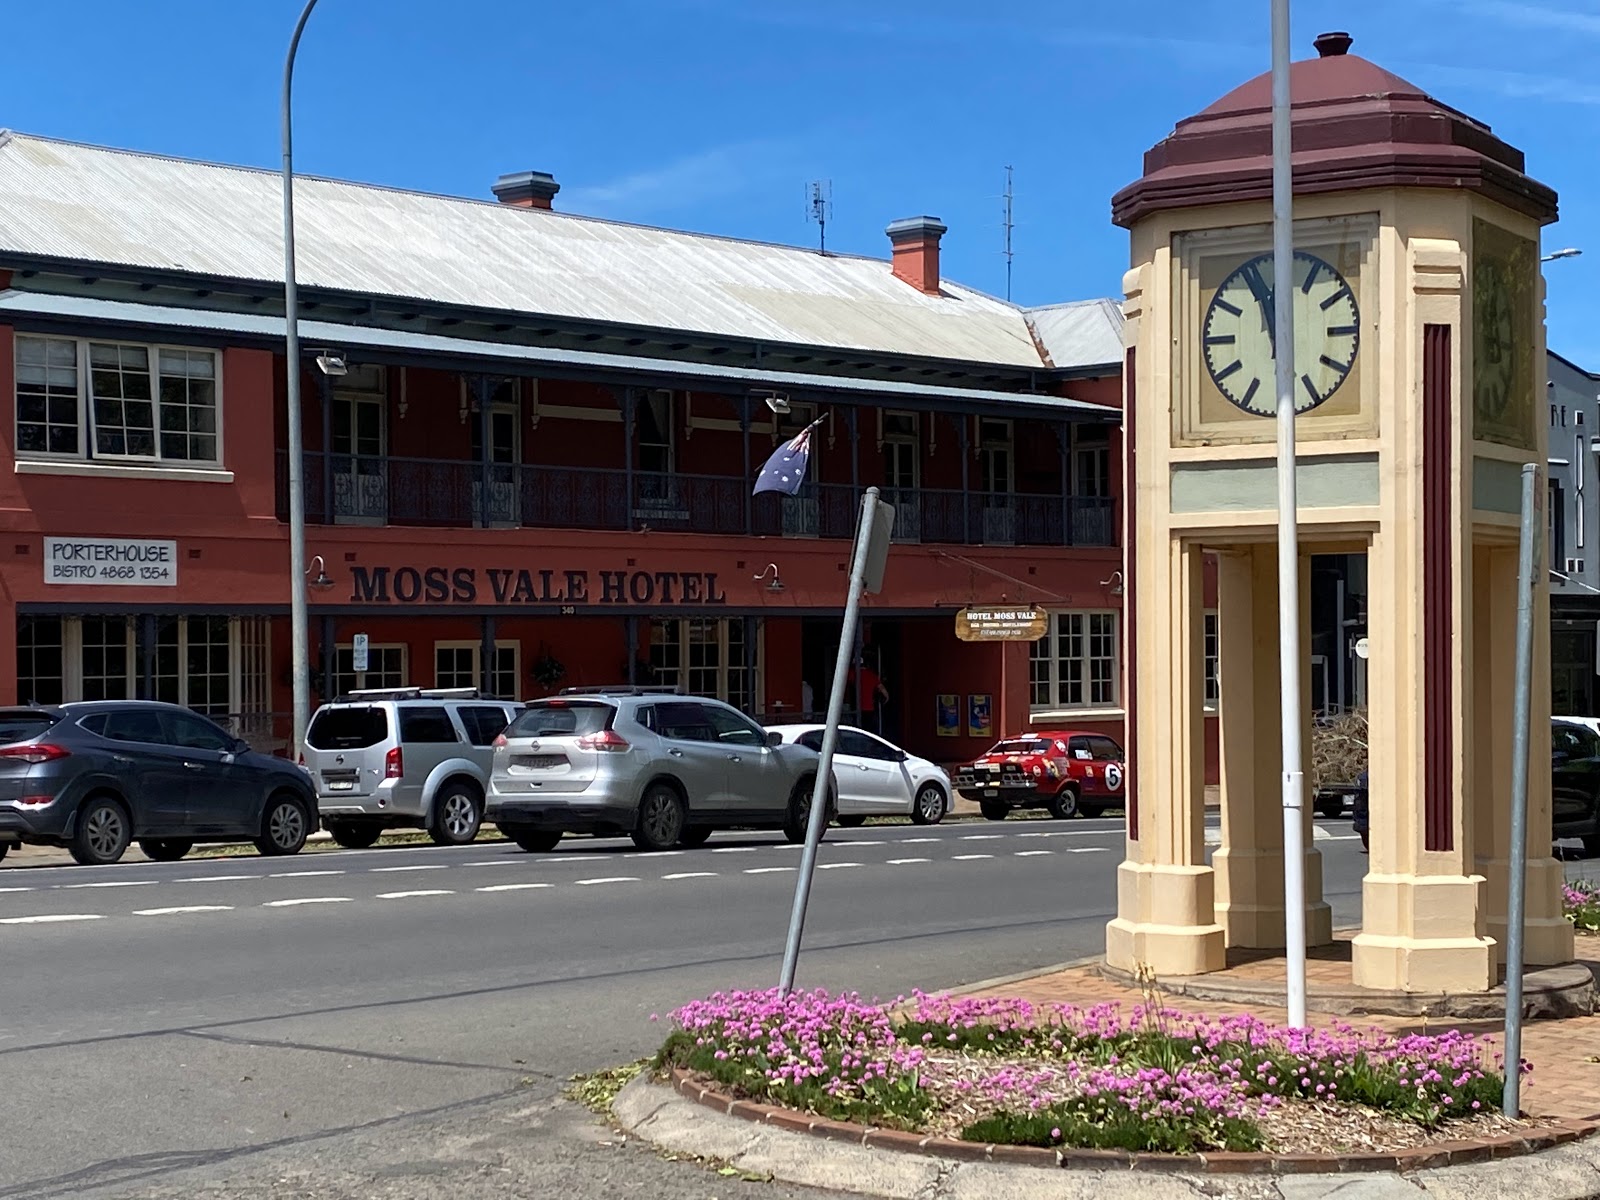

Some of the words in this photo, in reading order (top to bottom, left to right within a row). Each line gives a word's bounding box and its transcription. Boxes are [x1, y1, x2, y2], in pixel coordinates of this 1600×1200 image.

[52, 543, 169, 562] PORTERHOUSE
[53, 565, 96, 578] BISTRO
[100, 566, 136, 579] 4868
[139, 567, 169, 580] 1354
[350, 566, 476, 602] MOSS
[485, 568, 588, 602] VALE
[598, 570, 726, 604] HOTEL
[967, 612, 992, 620] HOTEL
[994, 612, 1016, 620] MOSS
[1017, 611, 1036, 620] VALE
[1108, 767, 1119, 787] 5
